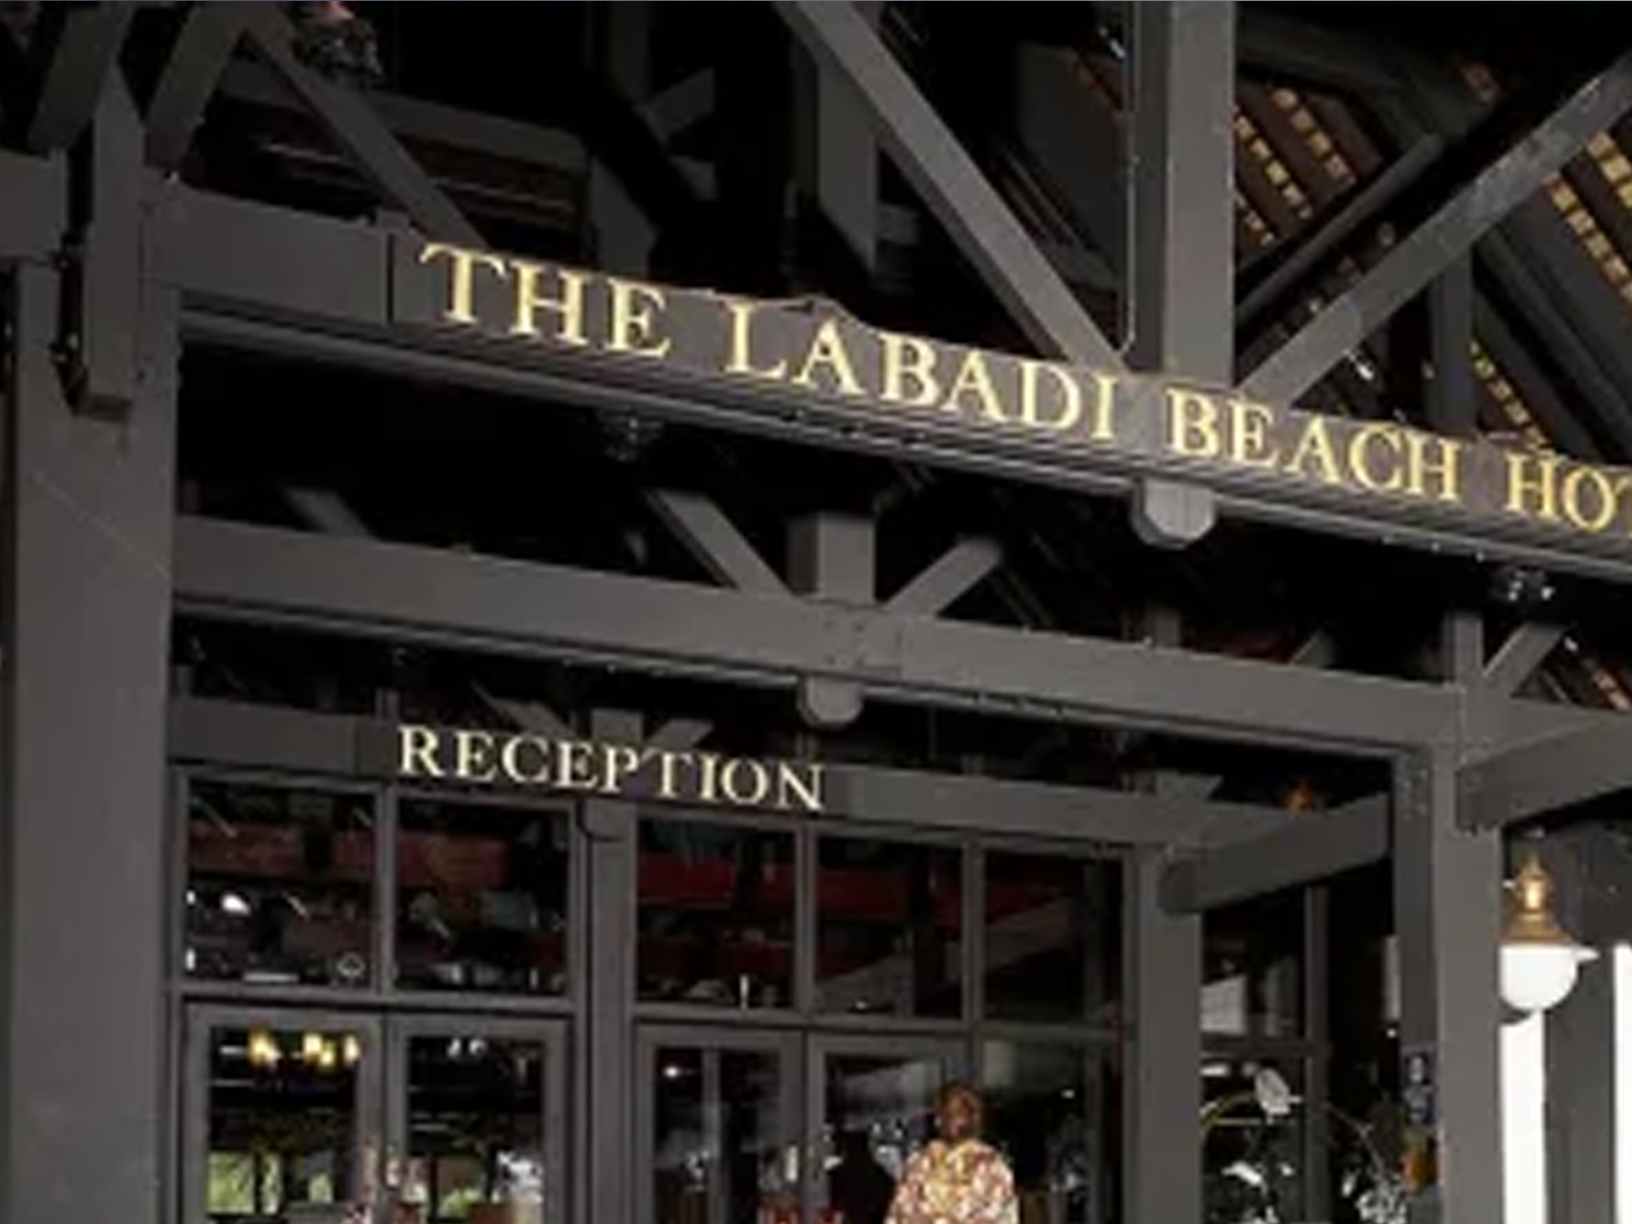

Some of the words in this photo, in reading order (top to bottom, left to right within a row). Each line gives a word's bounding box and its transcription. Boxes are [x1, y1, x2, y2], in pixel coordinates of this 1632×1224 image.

[419, 243, 673, 358] THE
[723, 299, 1119, 440] LABADI
[1166, 386, 1463, 500] BEACH
[398, 724, 824, 813] RECEPTION
